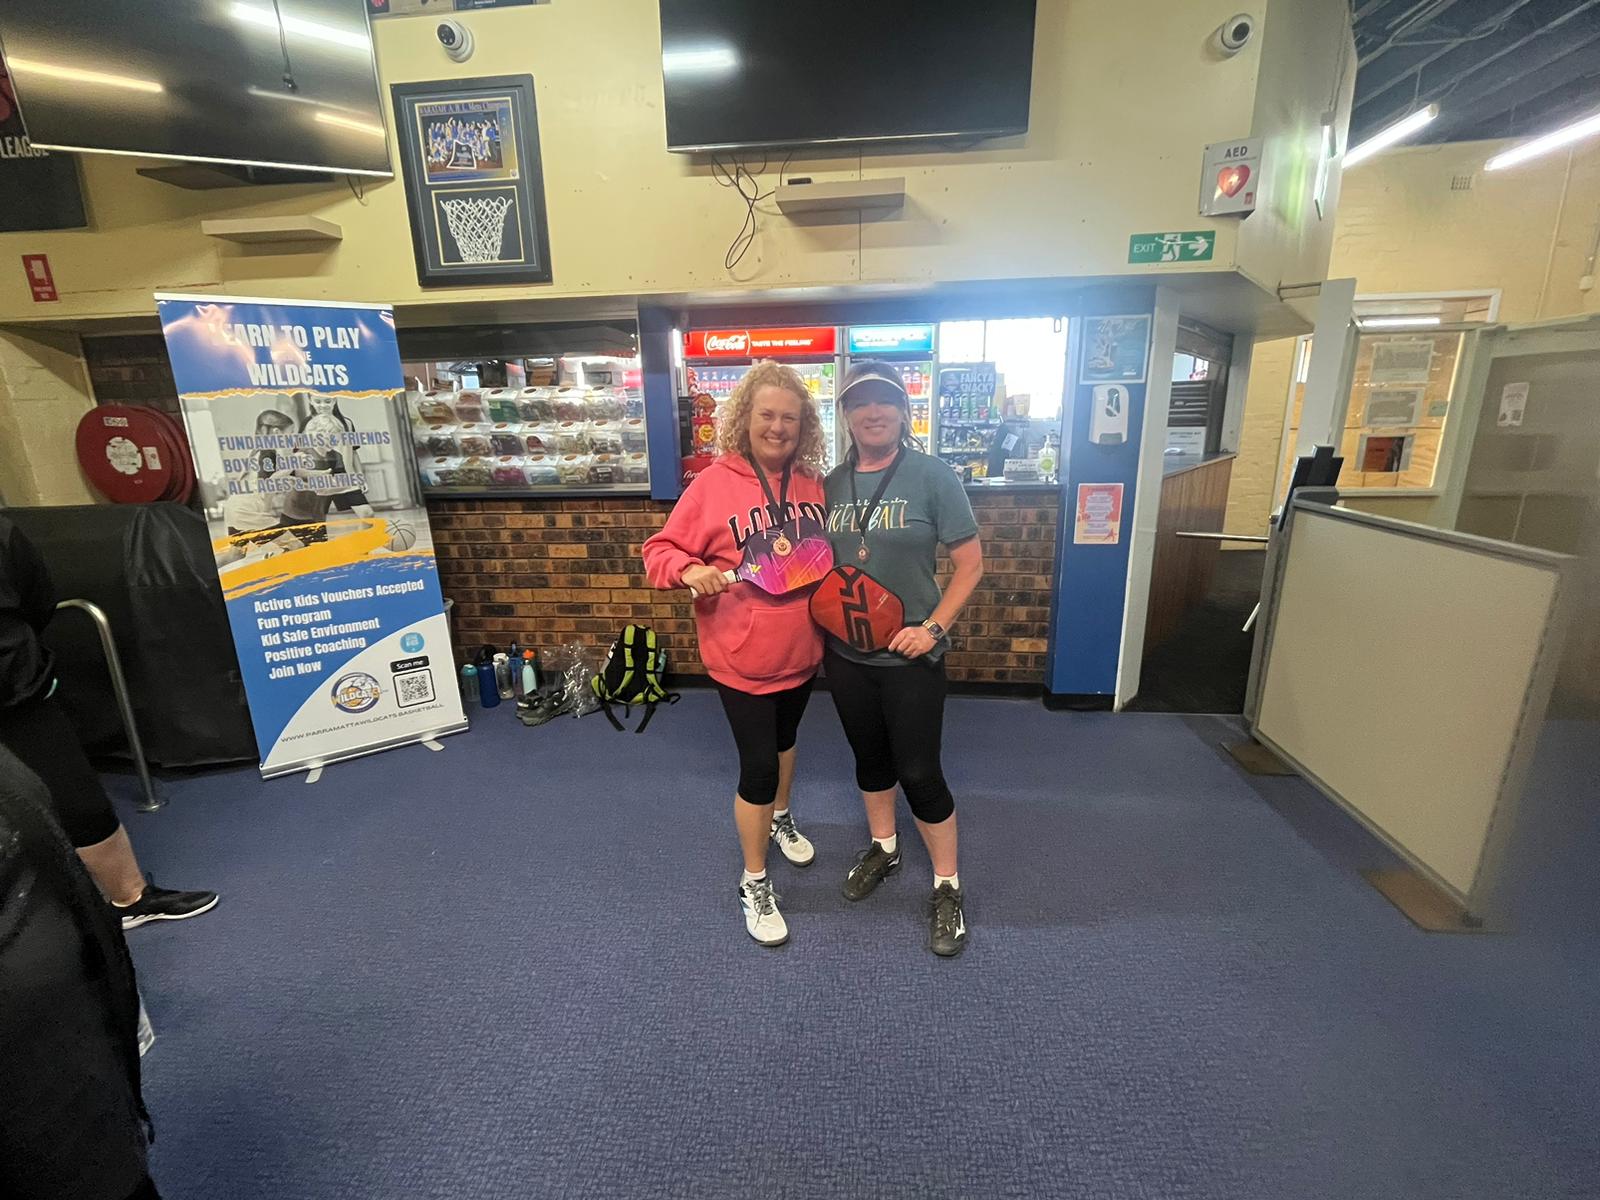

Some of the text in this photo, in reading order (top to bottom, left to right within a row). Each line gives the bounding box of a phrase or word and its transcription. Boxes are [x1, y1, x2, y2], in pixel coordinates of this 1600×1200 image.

[1224, 146, 1248, 159] AED
[1133, 242, 1157, 253] EXIT
[207, 323, 360, 350] ARN TO PLAY
[248, 363, 350, 387] WILDCATS
[218, 431, 391, 451] FUNDAMENTALS & FRIENDS
[223, 454, 316, 474] BOYS & GIRLS
[228, 473, 365, 496] ALL AGES & ABILITIES
[825, 503, 911, 533] ICKLBALL
[254, 578, 424, 614] Active Kids Vouchers Accepted
[257, 609, 332, 630] Fun Program
[261, 617, 381, 647] Kid Safe Environment
[264, 636, 367, 663] Positive Coaching
[269, 660, 322, 680] Join Now
[396, 662, 413, 670] Scan
[330, 686, 381, 707] WILDCATS
